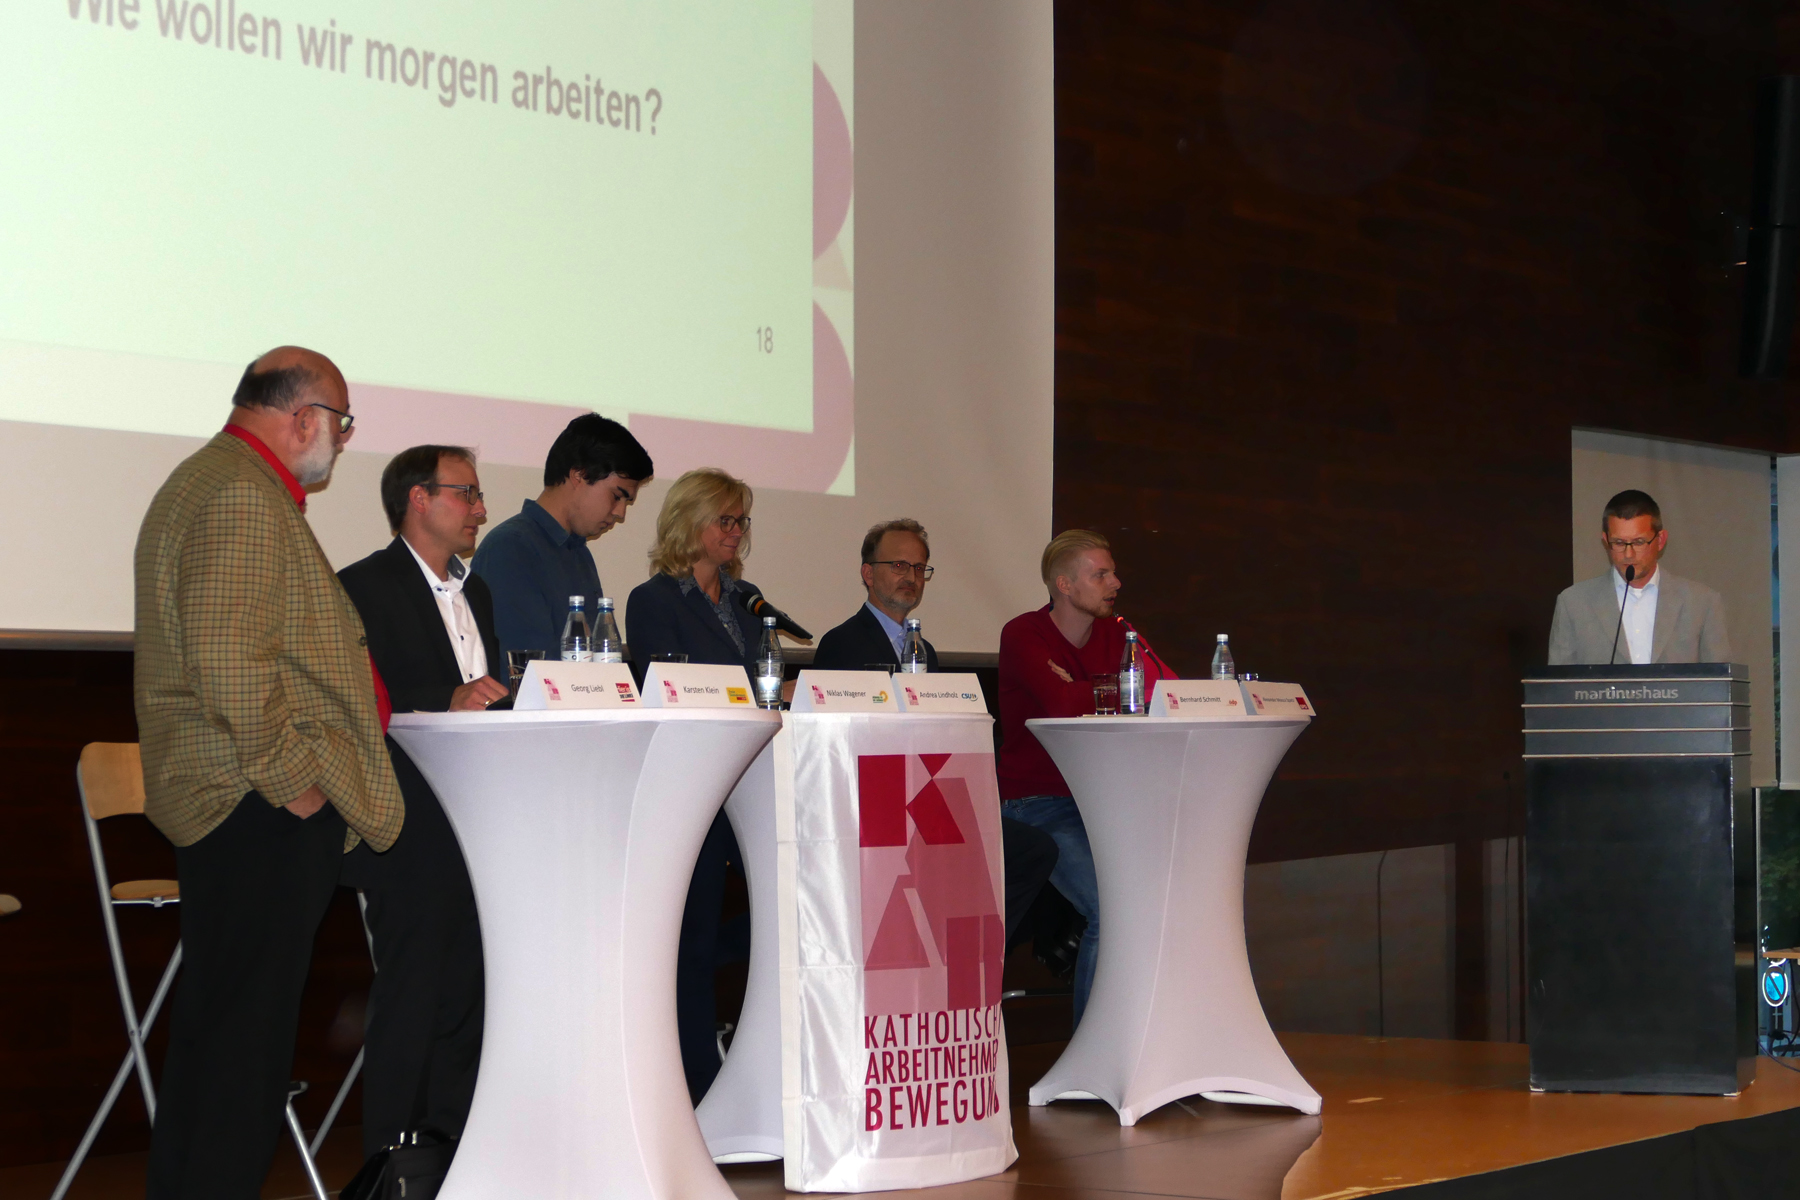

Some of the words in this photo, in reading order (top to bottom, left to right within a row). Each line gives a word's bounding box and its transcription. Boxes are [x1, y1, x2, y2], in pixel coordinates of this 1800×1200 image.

[156, 0, 282, 61] wollen
[297, 18, 353, 74] wir
[365, 38, 499, 108] morgen
[511, 65, 663, 136] arbeiten?
[756, 326, 774, 354] 18
[571, 684, 590, 693] Georg
[683, 686, 704, 694] Karsten
[705, 686, 720, 694] Klein
[843, 690, 867, 698] Wagener
[1574, 686, 1679, 700] martinushaus
